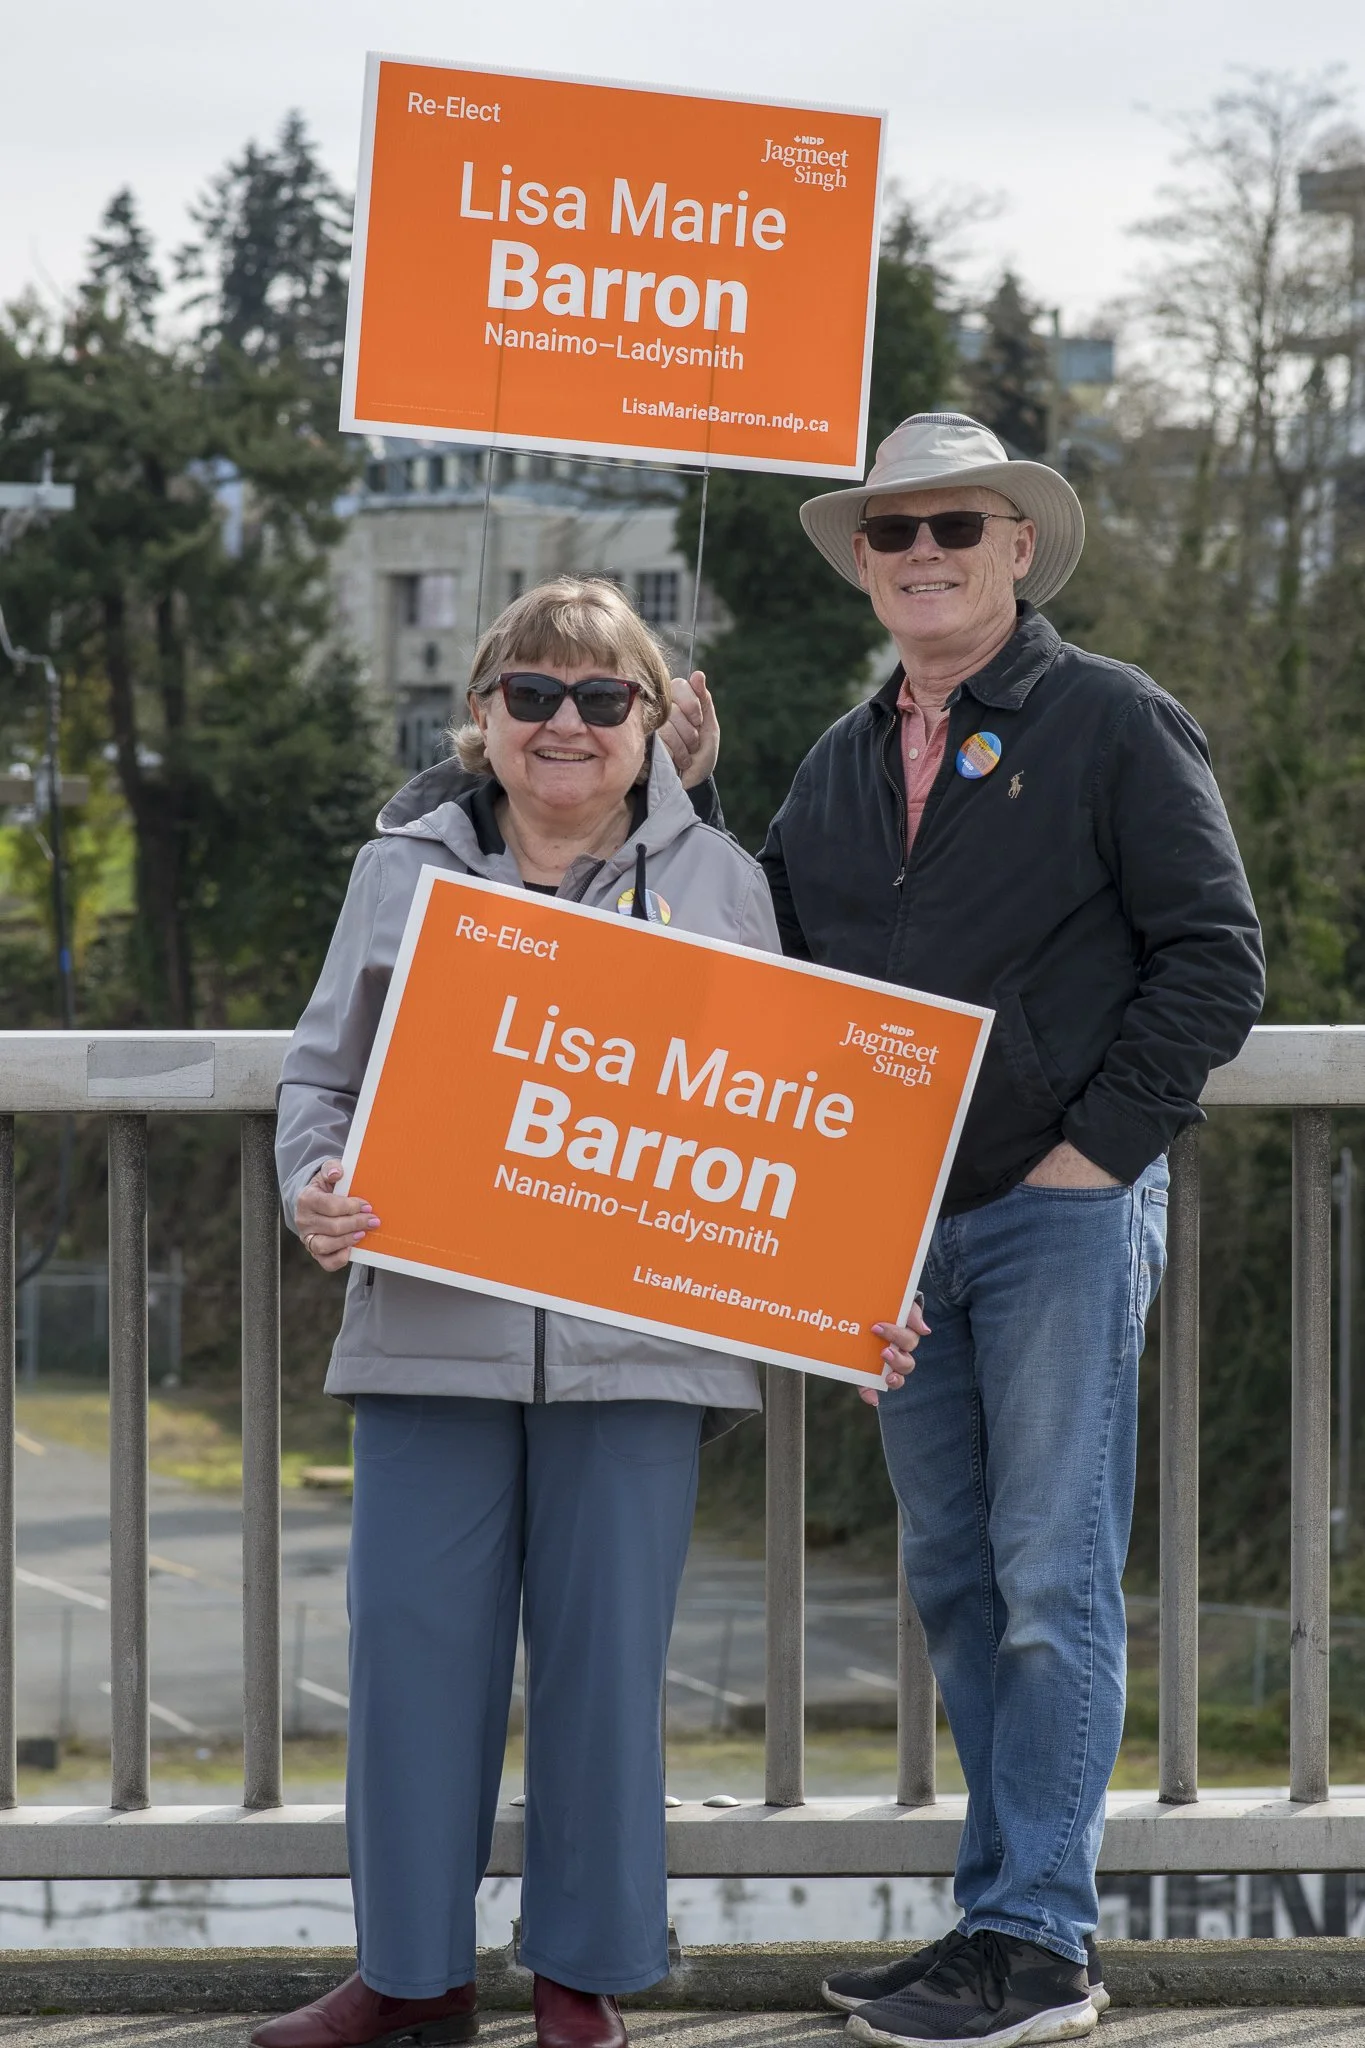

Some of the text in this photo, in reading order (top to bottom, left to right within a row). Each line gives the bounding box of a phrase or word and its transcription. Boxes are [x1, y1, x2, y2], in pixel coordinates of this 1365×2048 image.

[407, 91, 502, 123] Re-Elect
[760, 138, 849, 169] Jagmeet
[801, 135, 825, 146] NDP
[794, 165, 848, 192] Singh
[459, 161, 787, 251] Lisa Marie
[487, 238, 749, 334] Barron
[622, 397, 829, 434] LisaMarieBarron.ndp.ca
[455, 914, 560, 962] Re-Elect
[838, 1021, 940, 1065] Jagmeet
[888, 1023, 915, 1038] NDP
[491, 994, 855, 1139] Lisa Marie
[872, 1054, 932, 1087] Singh
[504, 1079, 797, 1220] Barron
[632, 1265, 861, 1336] LisaMarieBarron.ndp.ca
